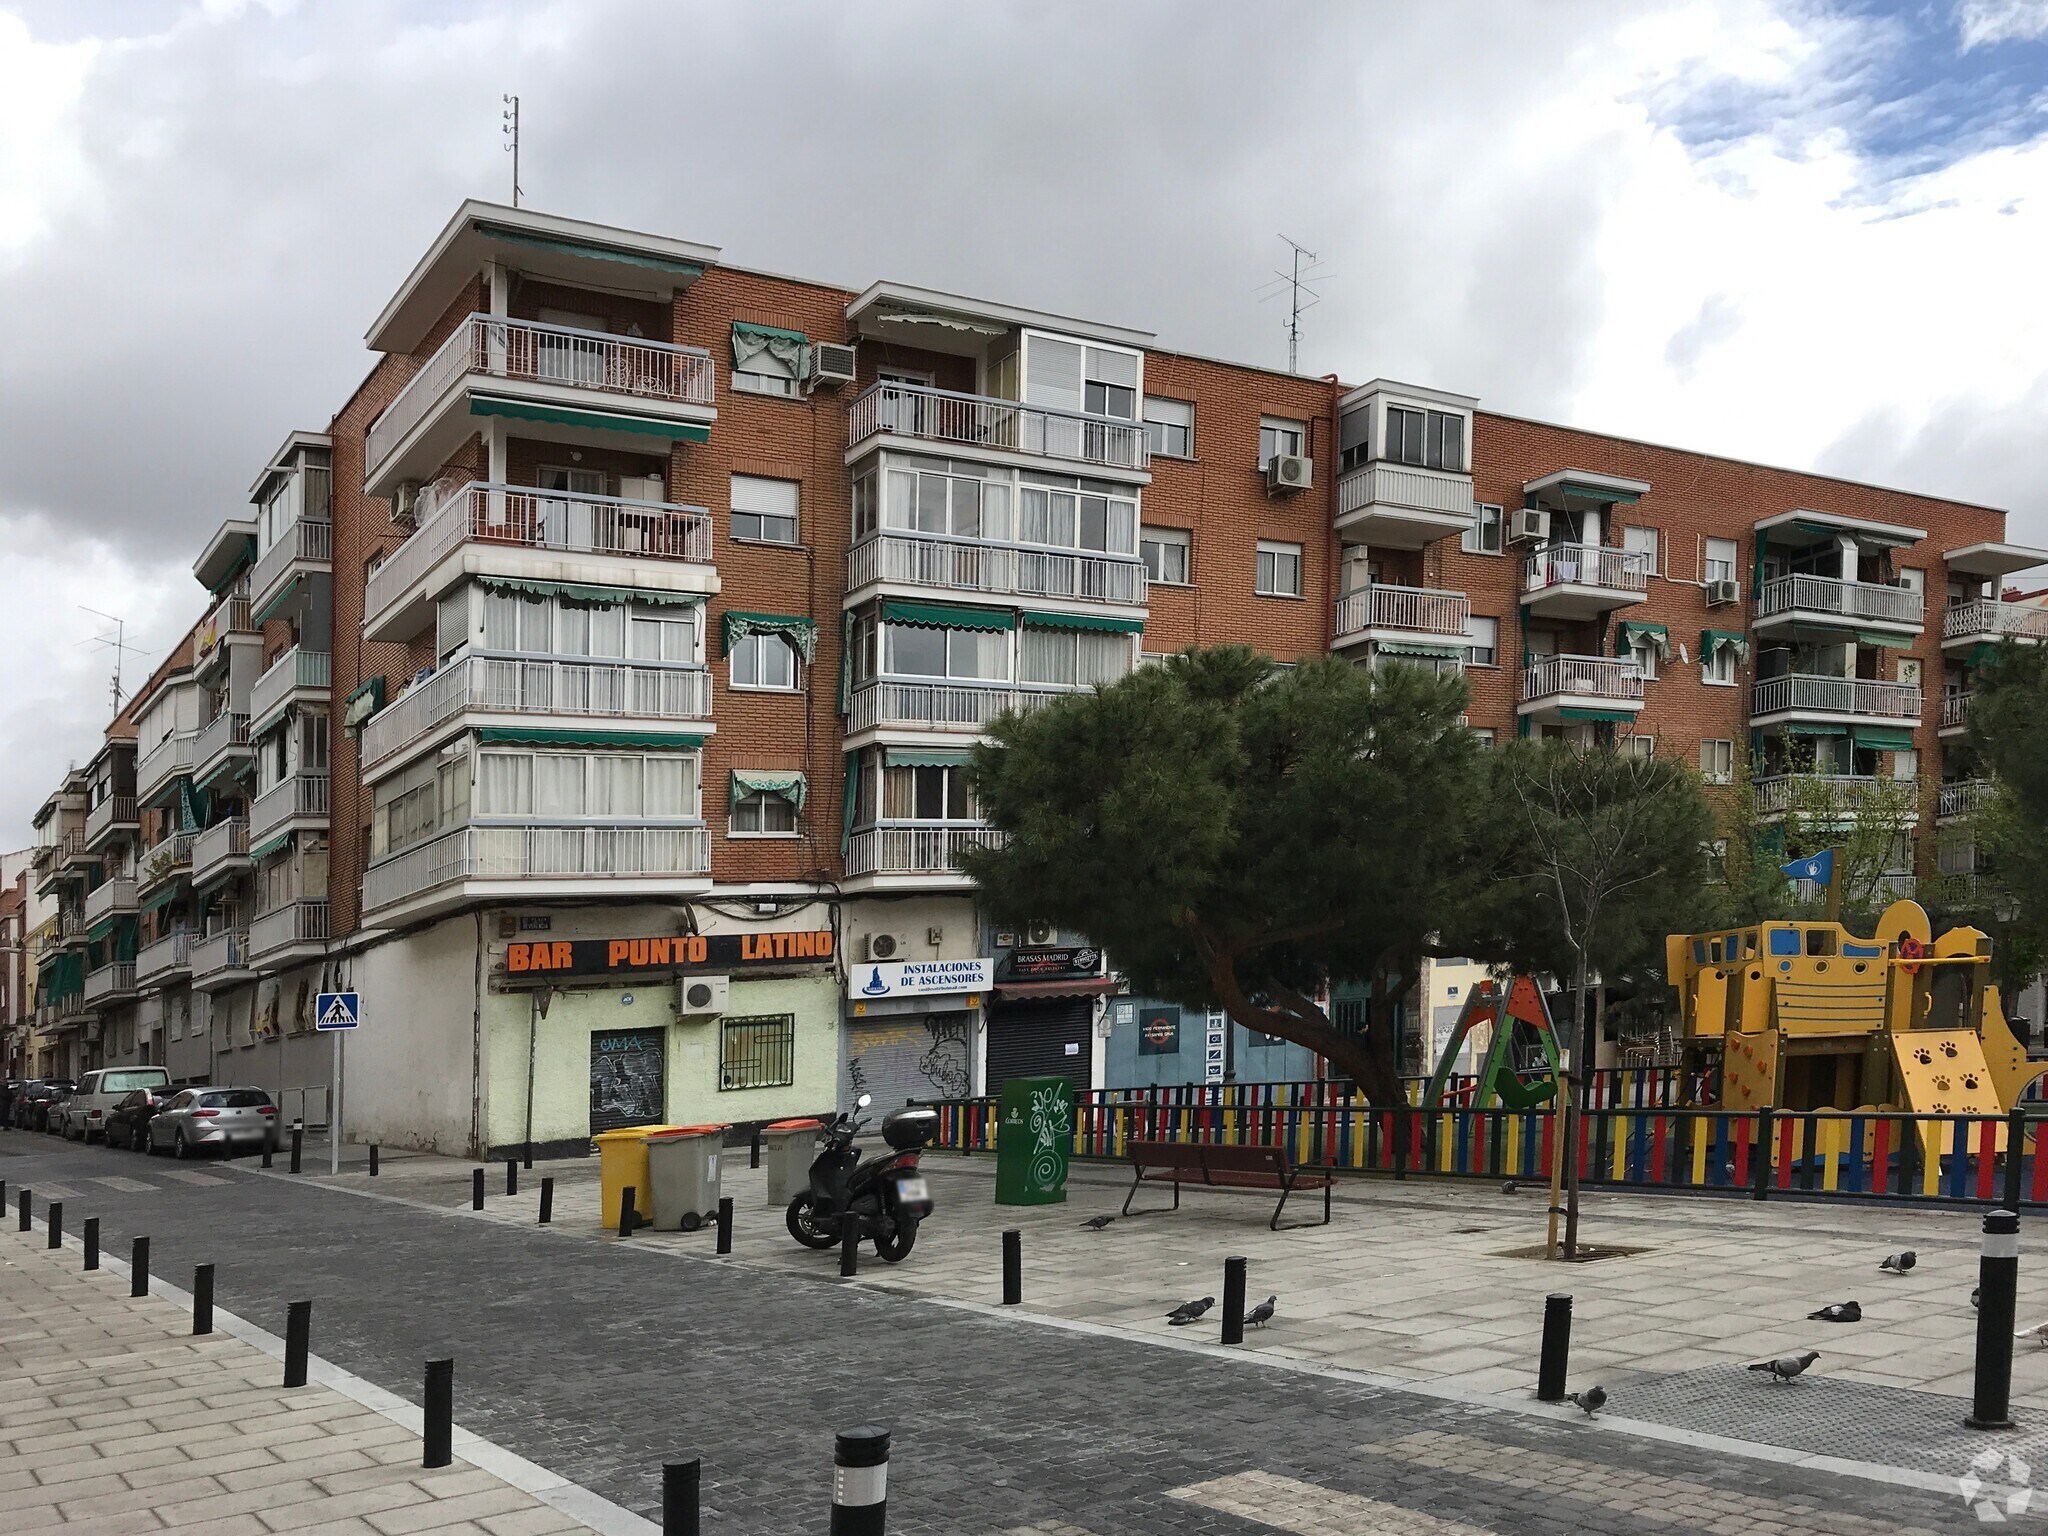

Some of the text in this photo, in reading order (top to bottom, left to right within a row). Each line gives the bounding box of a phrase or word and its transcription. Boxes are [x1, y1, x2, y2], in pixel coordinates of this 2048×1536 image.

[508, 931, 833, 972] BAR PUNTO LATINO
[1017, 955, 1041, 963] BRASAS
[1042, 953, 1069, 962] MADRID
[904, 962, 982, 975] INSTALACIONES
[901, 973, 984, 987] DE ASCENSORES
